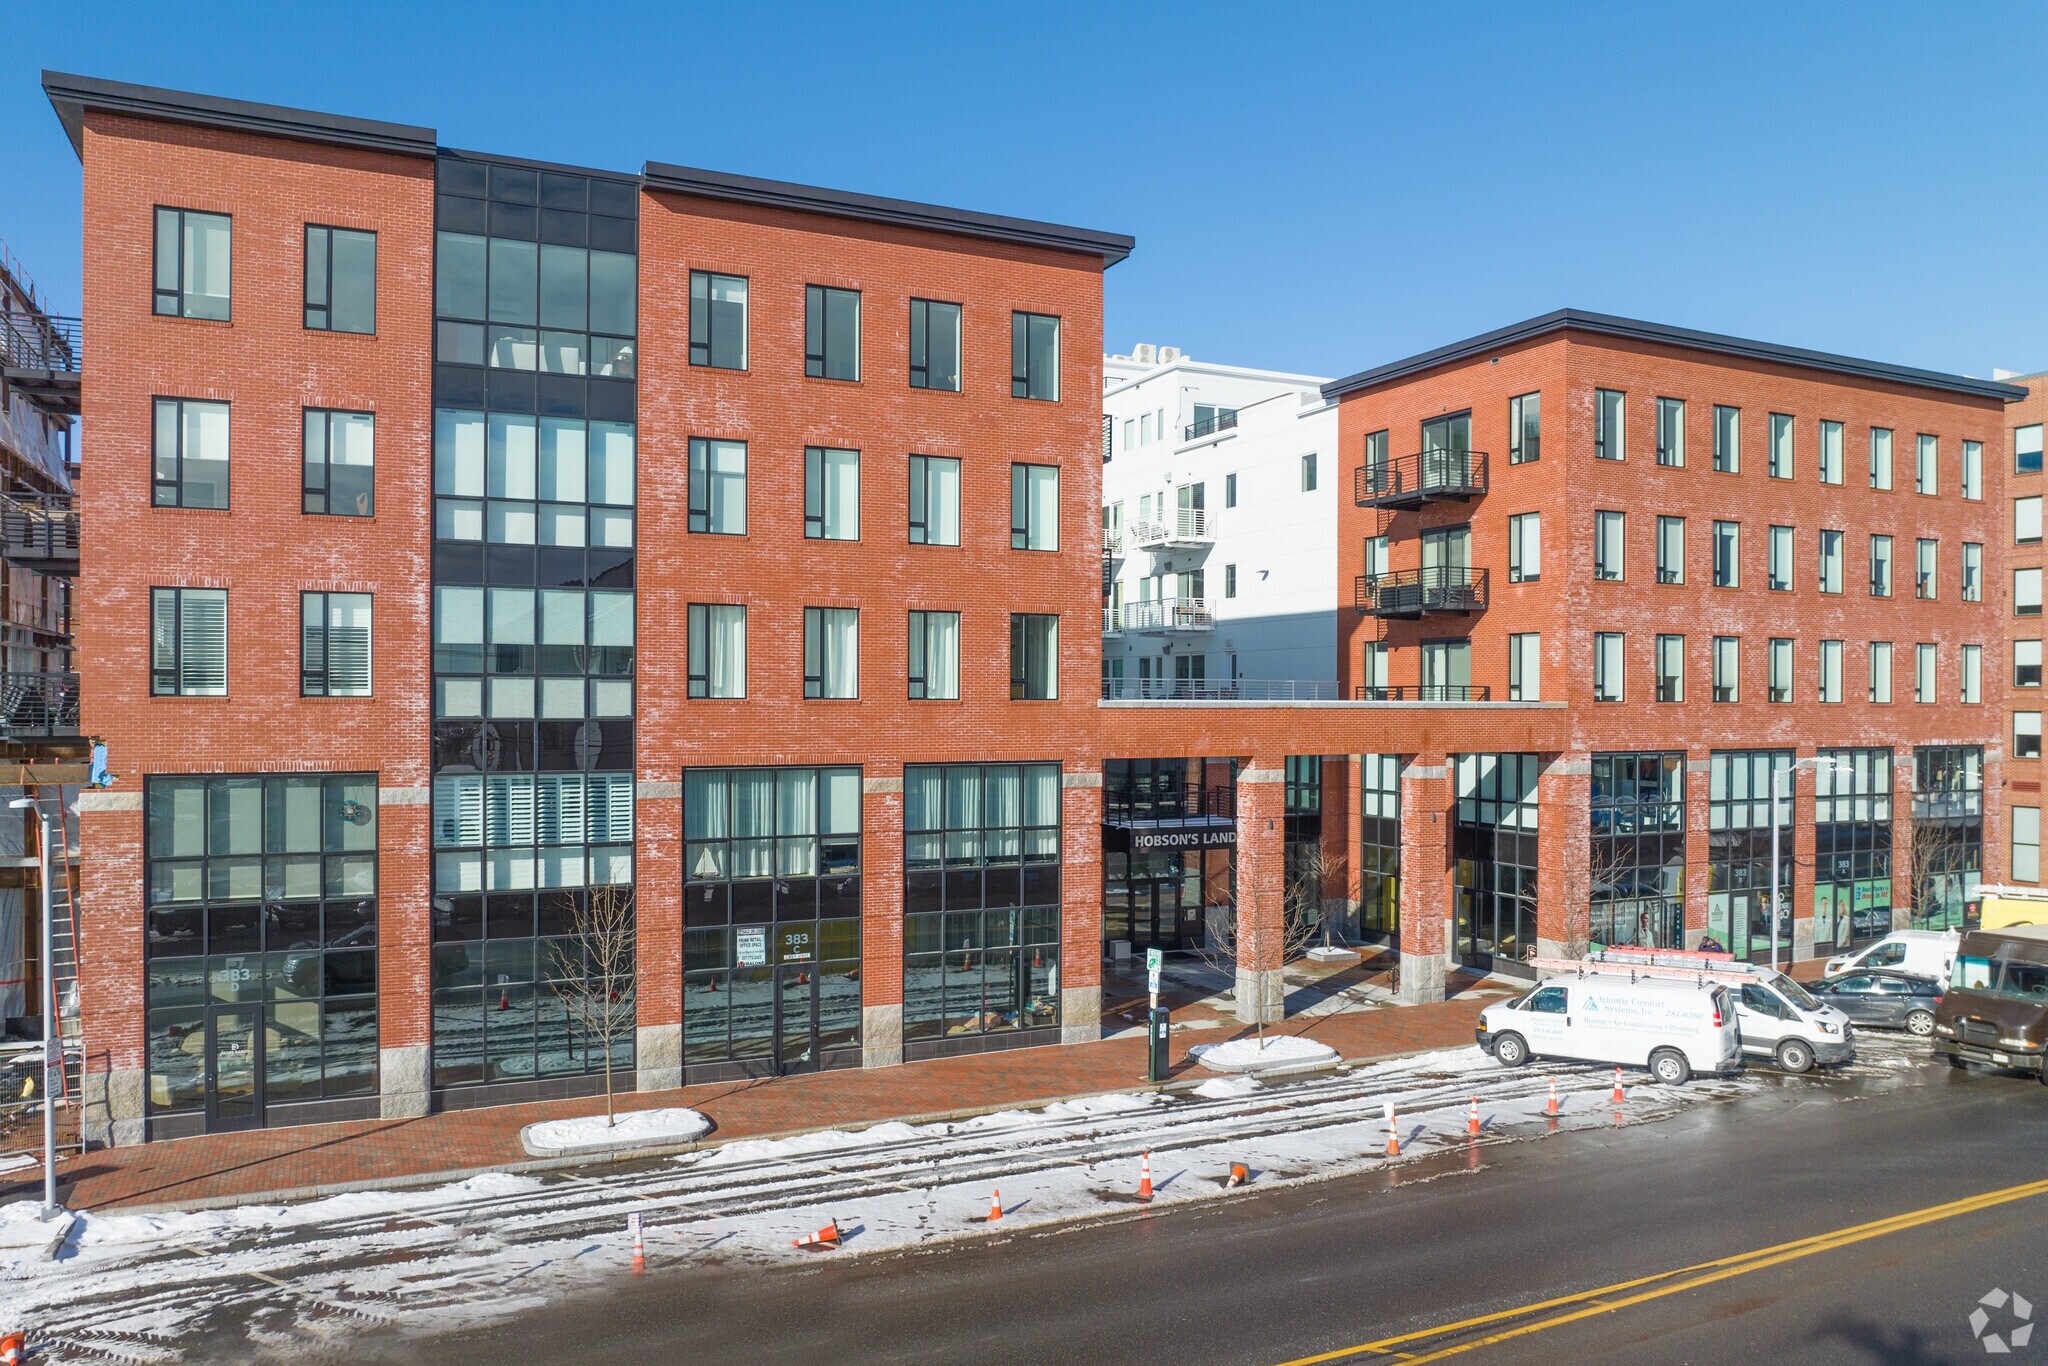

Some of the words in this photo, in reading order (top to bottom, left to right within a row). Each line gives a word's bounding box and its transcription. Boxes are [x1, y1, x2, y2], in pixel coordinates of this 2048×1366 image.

[1135, 832, 1199, 847] HOBSON'S
[1203, 831, 1237, 844] LAND
[1838, 860, 1850, 868] 383
[1734, 868, 1747, 877] 383
[785, 933, 808, 945] 383
[793, 945, 800, 954] C
[219, 968, 250, 981] 383
[231, 982, 239, 992] D
[1597, 995, 1628, 1006] Atlantic
[1631, 998, 1664, 1008] Comfort
[1604, 1005, 1639, 1016] Systems,
[1641, 1007, 1656, 1016] Inc.
[1665, 1010, 1703, 1020] 284-6360
[1584, 1017, 1607, 1026] Heating
[1623, 1020, 1663, 1031] Conditioning
[1669, 1024, 1700, 1034] Plumbing
